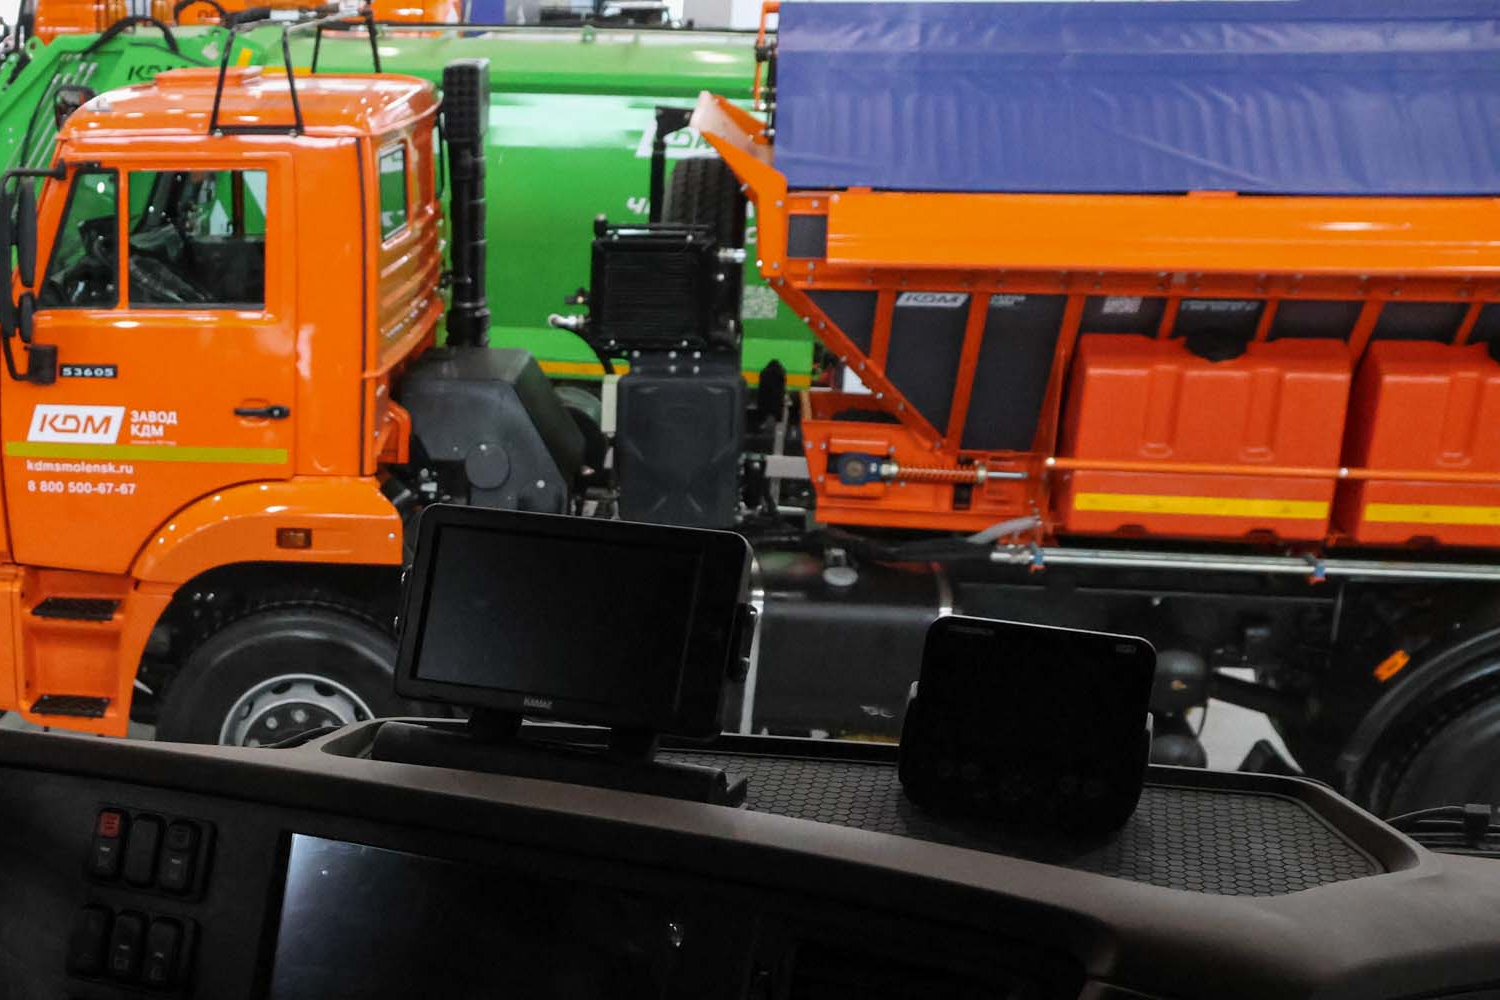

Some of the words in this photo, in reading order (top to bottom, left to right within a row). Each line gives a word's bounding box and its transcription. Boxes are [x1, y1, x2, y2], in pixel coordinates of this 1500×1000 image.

[62, 367, 114, 377] 53605
[131, 410, 177, 424] ЗАВОД
[39, 414, 113, 434] KDM
[130, 424, 164, 437] КДМ
[26, 460, 134, 475] kdmsmolensk.ru
[27, 480, 37, 492] 8
[39, 481, 65, 493] 800
